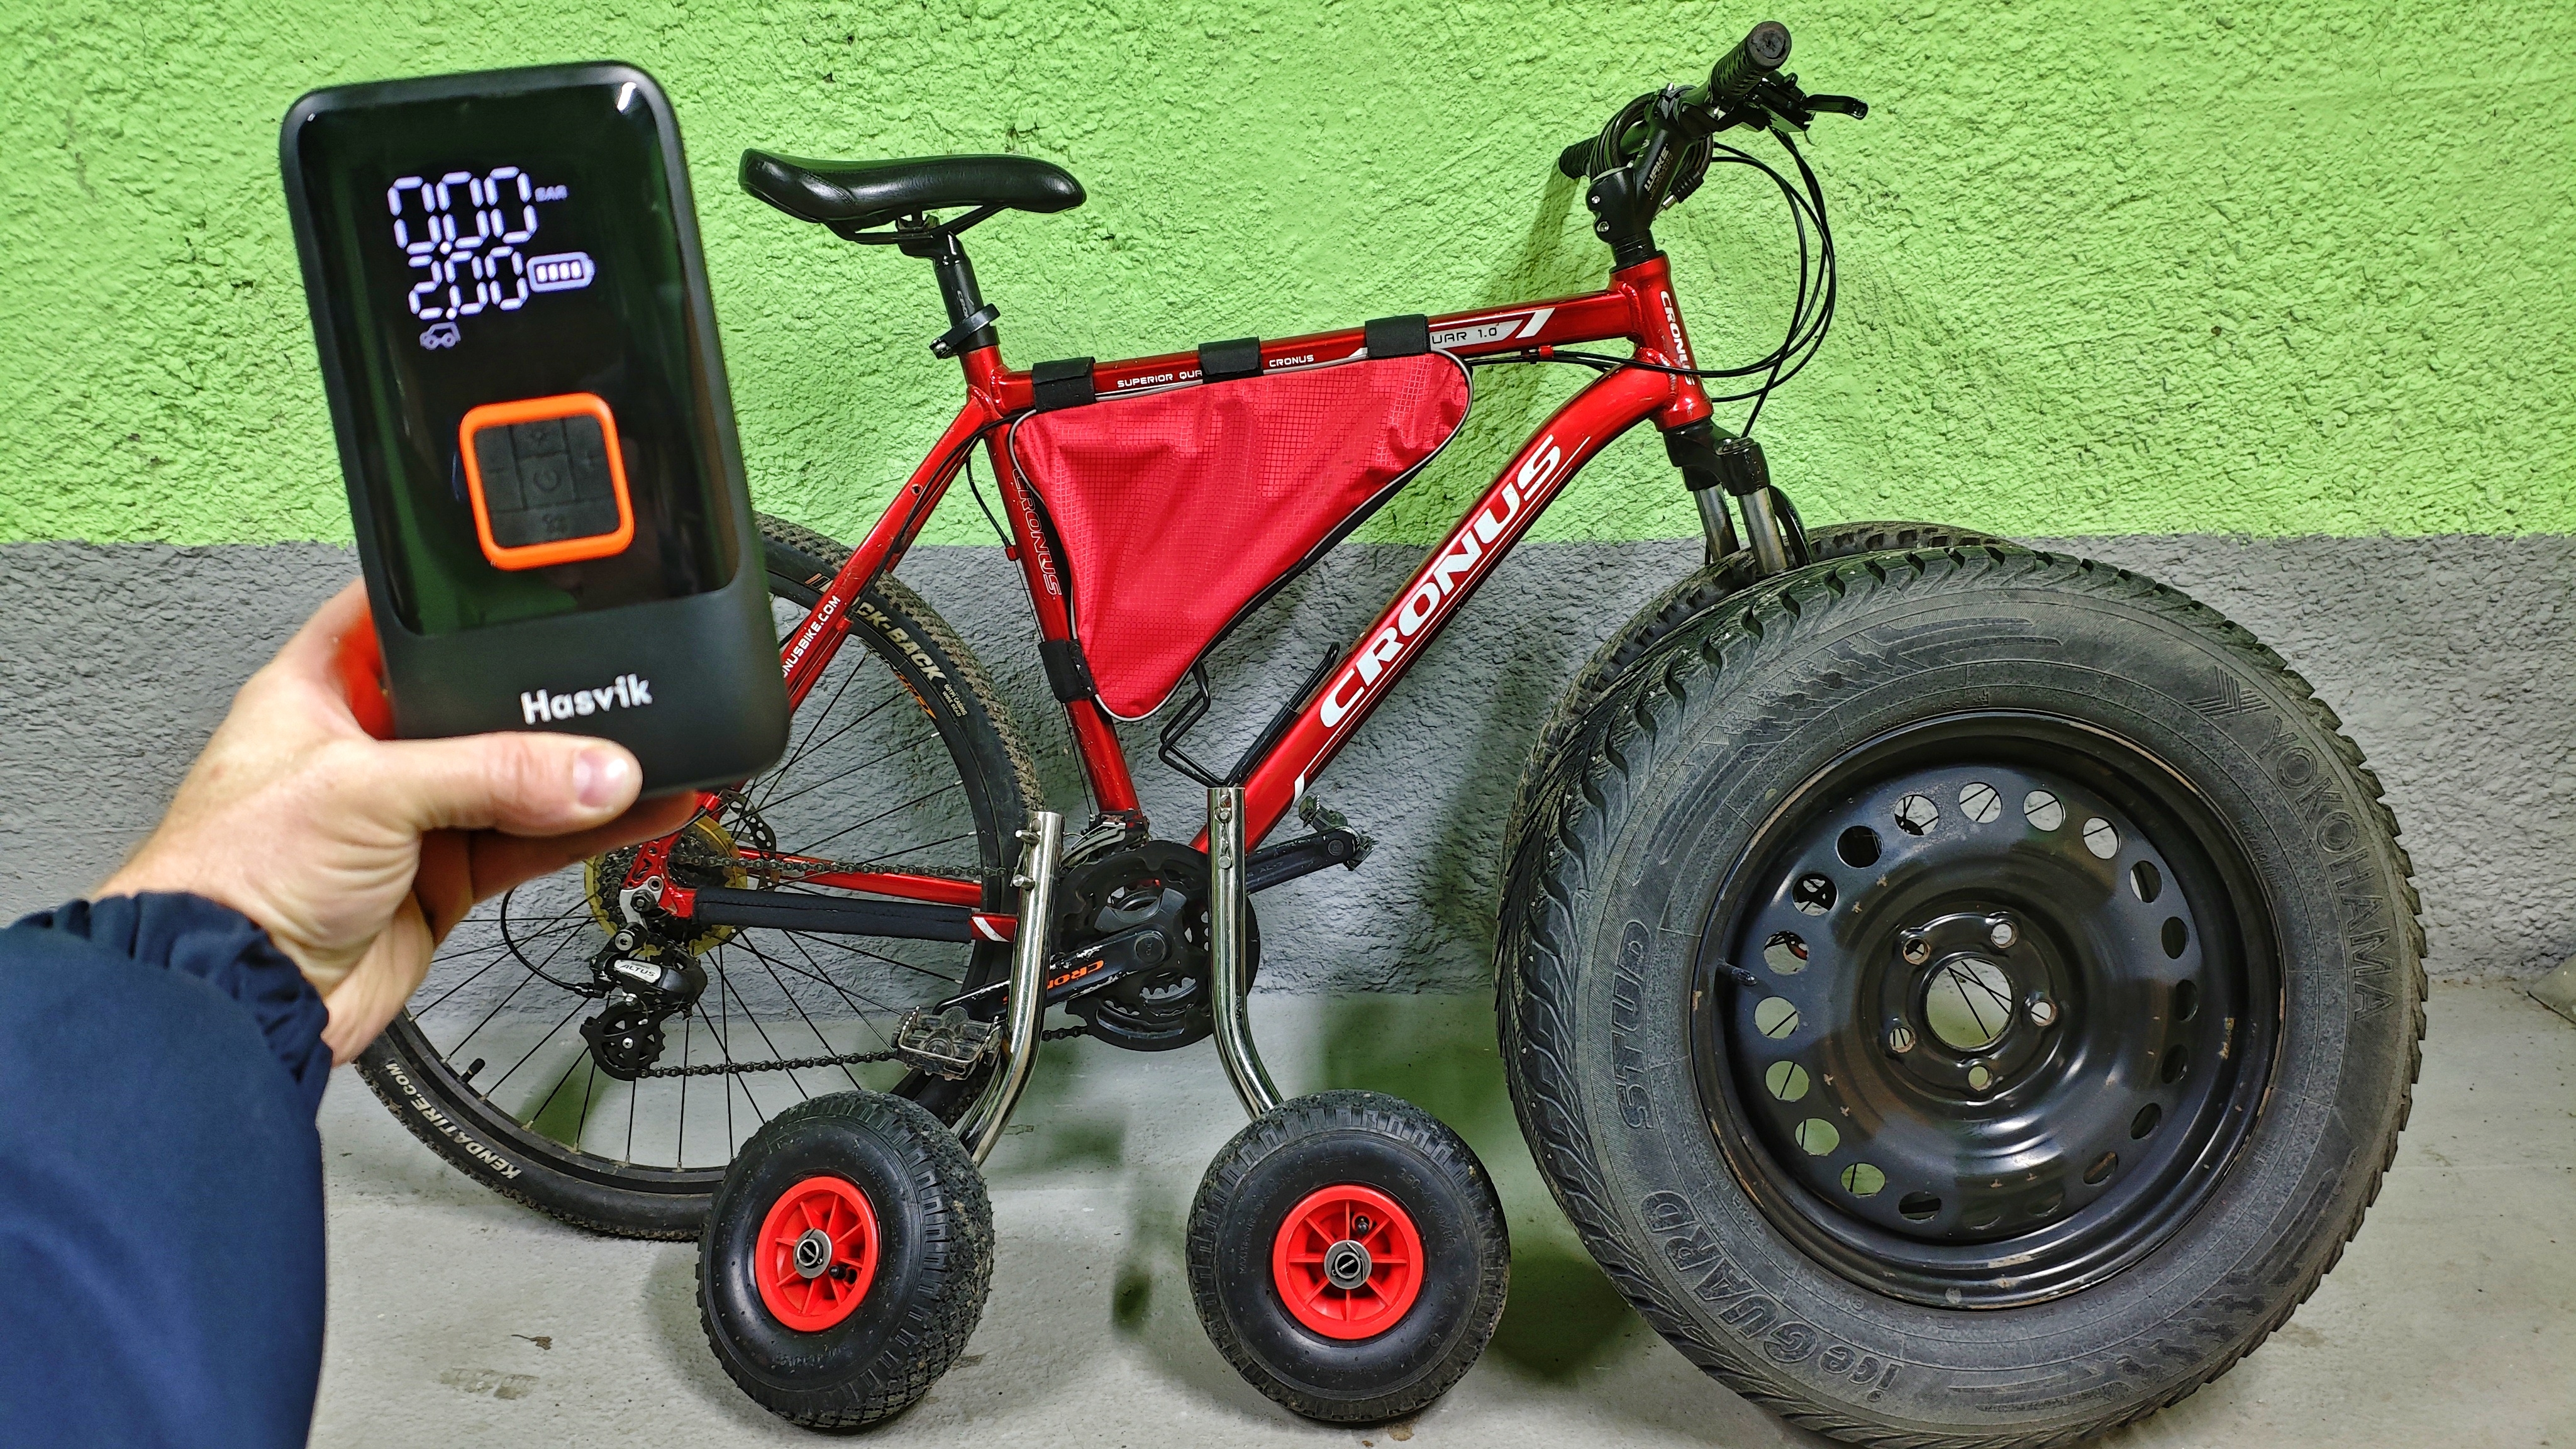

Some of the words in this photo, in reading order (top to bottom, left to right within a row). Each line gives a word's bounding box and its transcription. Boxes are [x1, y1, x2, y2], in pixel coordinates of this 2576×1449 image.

[535, 184, 569, 203] BAR
[408, 246, 530, 320] 2.00
[1432, 331, 1467, 344] UAR
[1478, 327, 1497, 338] 1.0
[1117, 373, 1173, 388] SUPERIOR
[1179, 370, 1203, 380] QUA
[1269, 355, 1314, 367] CRONUS
[1320, 434, 1562, 728] CRONUS
[852, 596, 947, 682] CK-BACK
[520, 672, 653, 726] Hasvik
[950, 703, 962, 716] BEAD
[953, 697, 968, 716] CASING
[2255, 714, 2395, 1022] YOKOHAMA
[619, 964, 656, 977] ALTUS
[1611, 919, 1654, 1130] STUD
[385, 1059, 523, 1179] KENDATIRE.COM
